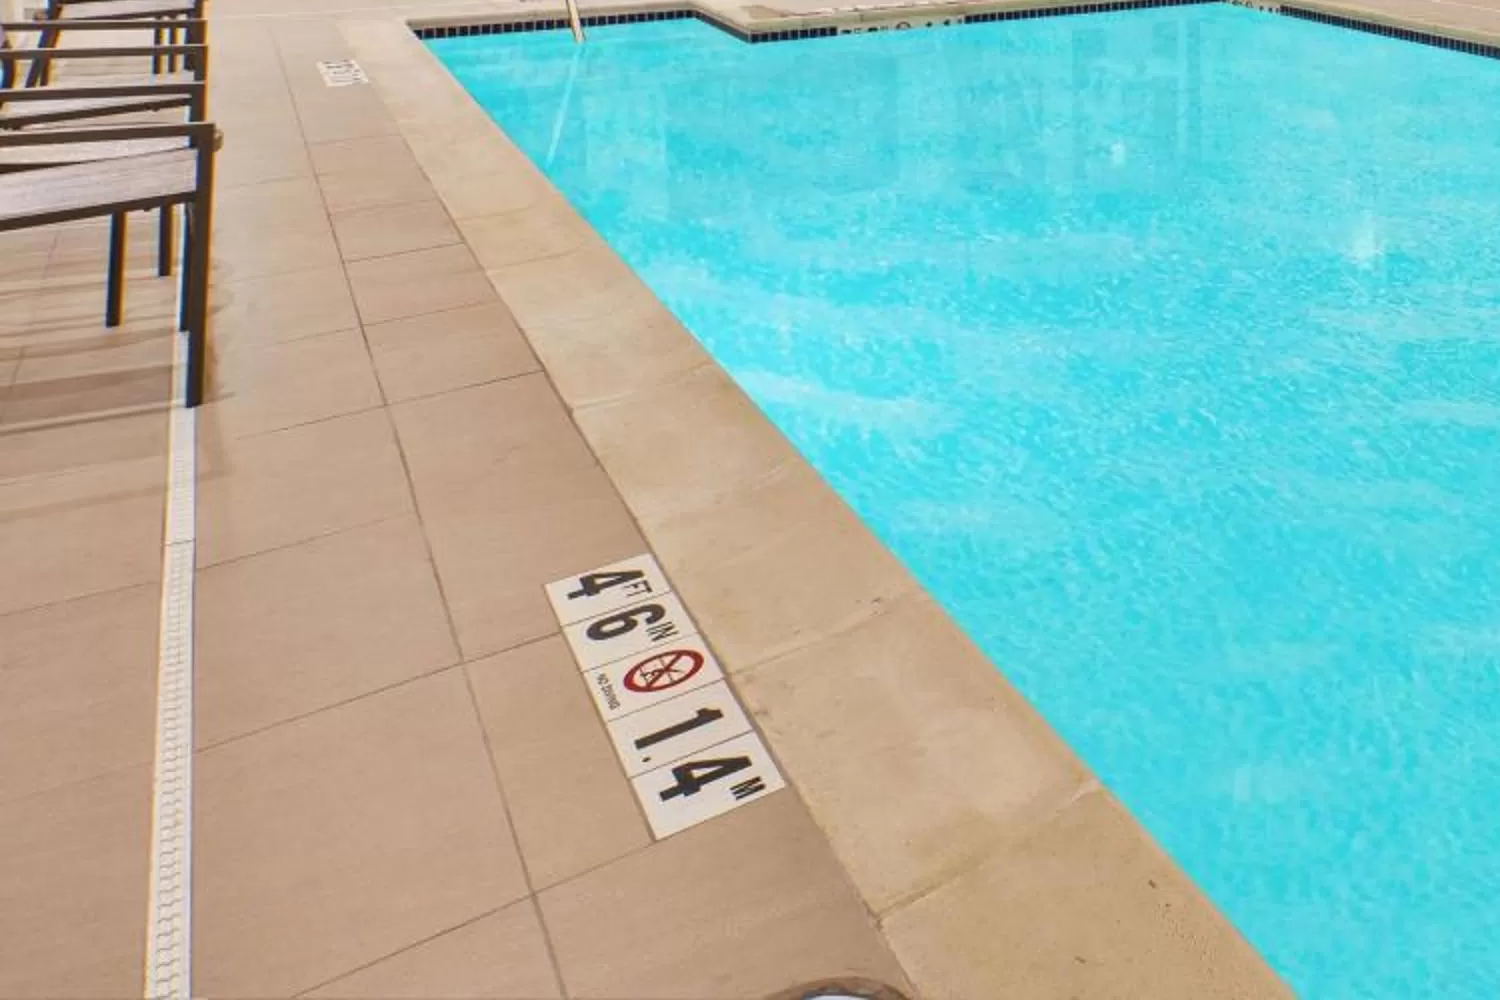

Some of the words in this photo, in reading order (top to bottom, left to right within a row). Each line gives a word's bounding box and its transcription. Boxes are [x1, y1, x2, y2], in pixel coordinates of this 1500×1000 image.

[567, 569, 645, 600] 4
[623, 579, 652, 598] FT
[586, 603, 666, 641] 6
[646, 621, 679, 642] IN
[729, 776, 767, 801] M
